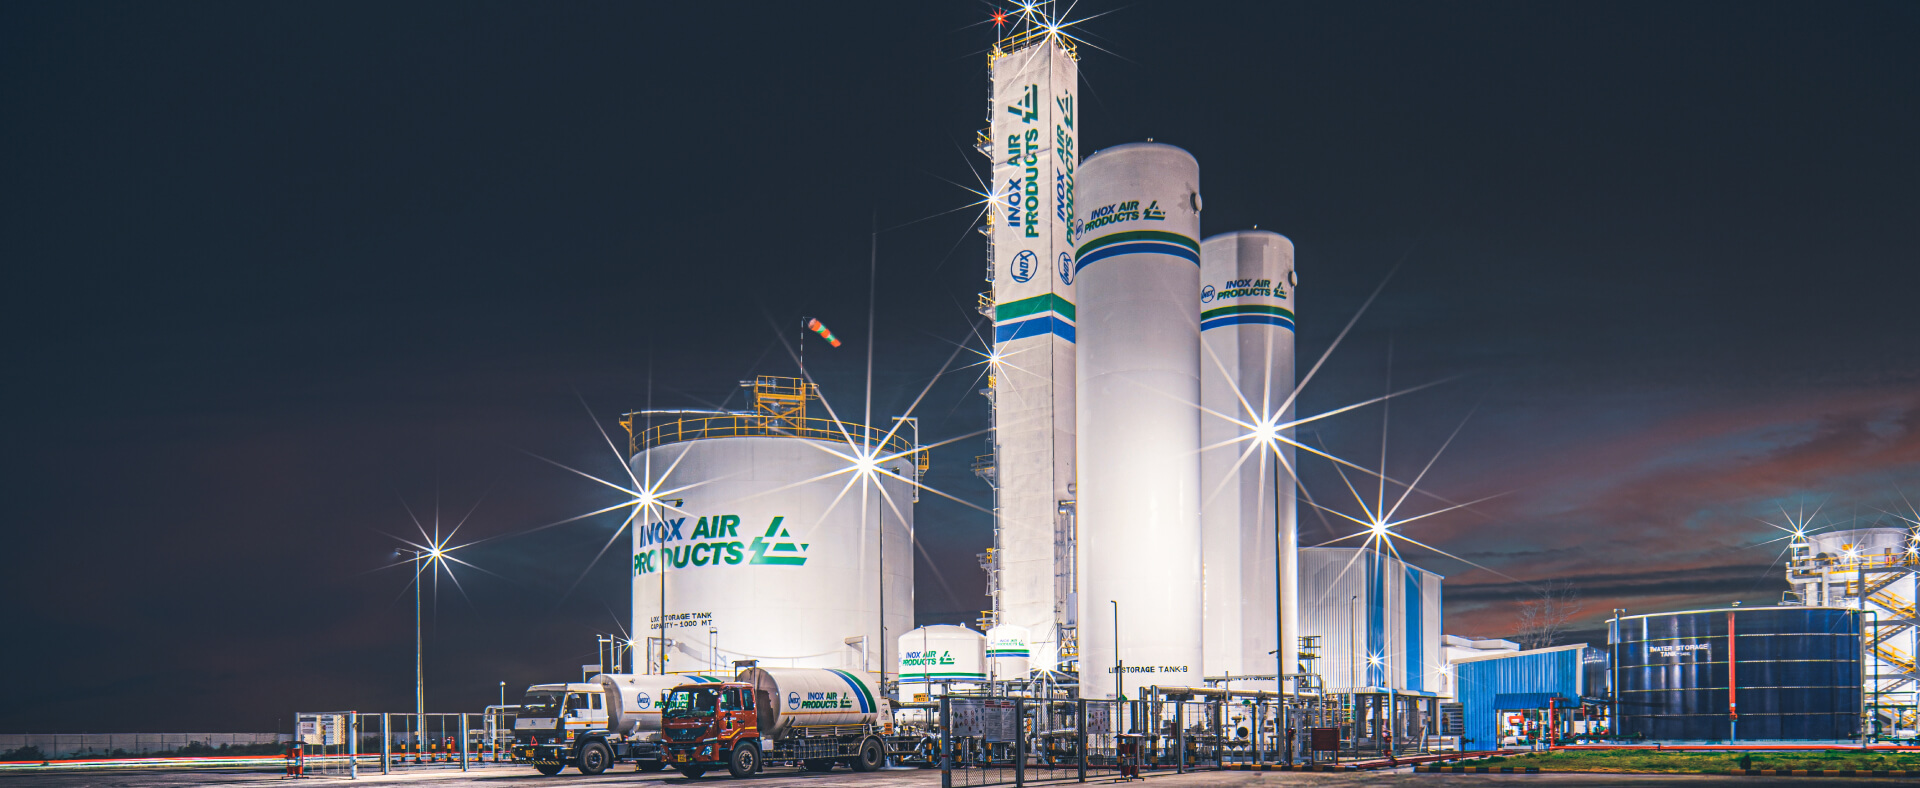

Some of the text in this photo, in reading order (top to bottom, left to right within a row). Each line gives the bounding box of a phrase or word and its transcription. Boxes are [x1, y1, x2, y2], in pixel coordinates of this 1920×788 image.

[1007, 134, 1021, 227] INOX AIR
[1024, 128, 1039, 238] PRODUCTS
[1057, 167, 1065, 223] INOX
[1066, 134, 1074, 248] PRODUCTS
[1091, 201, 1139, 220] INOX AIR
[1084, 211, 1139, 234] PRODUCTS
[1226, 279, 1251, 289] INOX
[1217, 288, 1271, 300] PRODUCTS
[640, 514, 740, 548] INOX AIR
[661, 613, 690, 621] TORAGE
[903, 658, 936, 666] PRODUCTS
[801, 700, 837, 709] PRODUCTS
[808, 692, 837, 700] INOX AIR
